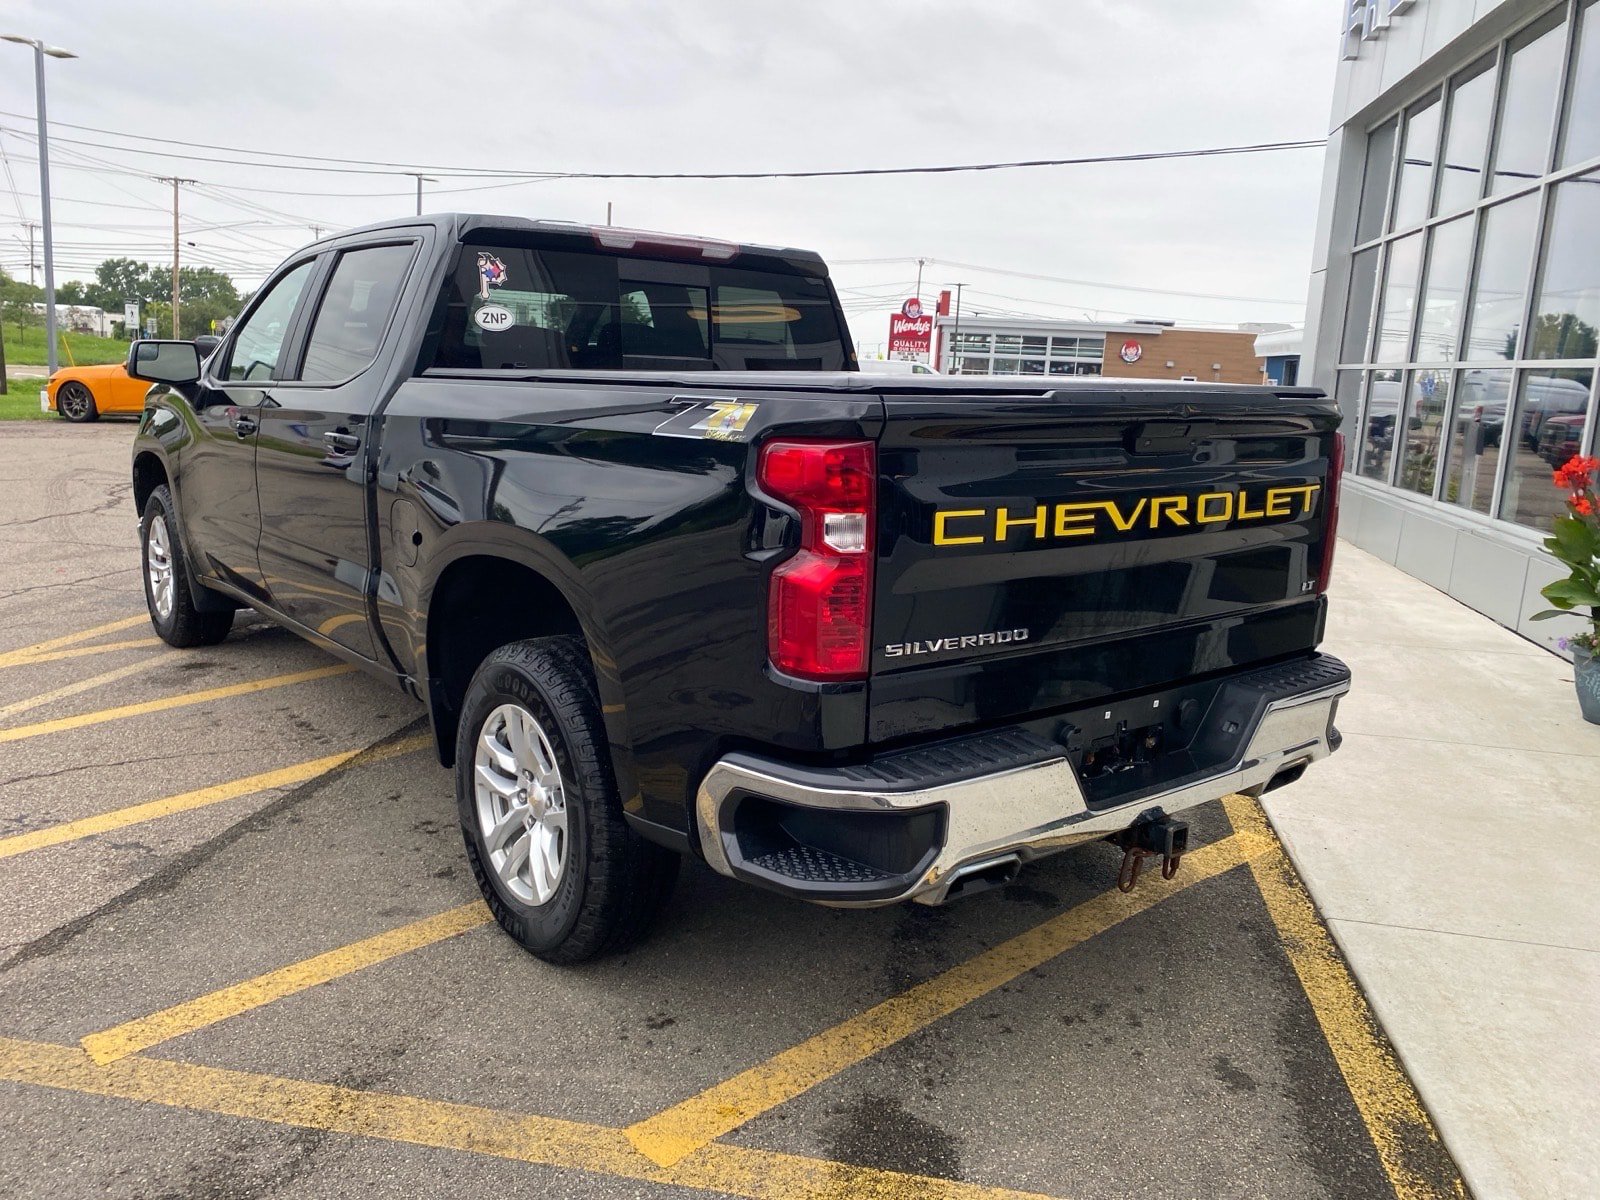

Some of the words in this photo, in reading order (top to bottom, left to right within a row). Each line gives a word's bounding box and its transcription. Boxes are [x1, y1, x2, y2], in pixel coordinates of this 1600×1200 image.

[482, 312, 508, 324] ZNP
[893, 318, 931, 335] Wendy's
[893, 340, 928, 348] QUALITY
[933, 484, 1320, 546] CHEVROLET
[1301, 580, 1316, 592] LT
[884, 627, 1029, 657] SILVERADO
